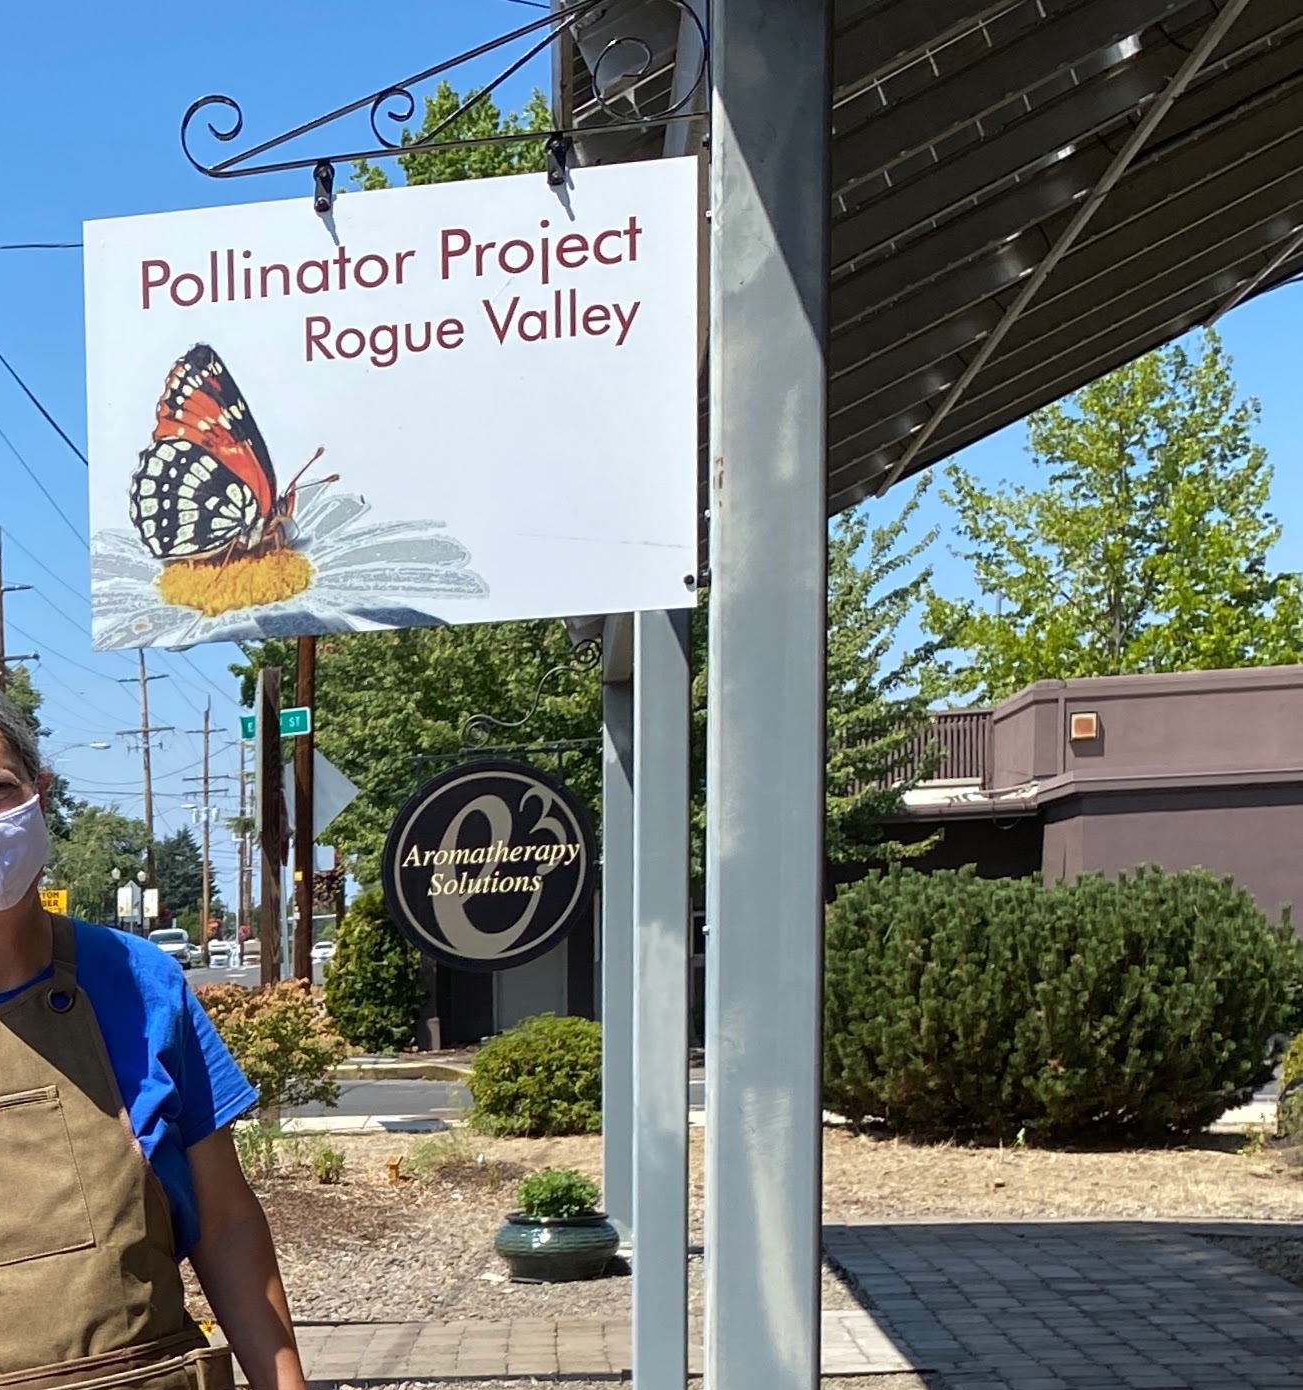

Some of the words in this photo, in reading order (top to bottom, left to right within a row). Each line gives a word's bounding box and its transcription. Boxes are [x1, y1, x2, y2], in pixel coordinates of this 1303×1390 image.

[140, 245, 416, 311] Pollinator
[439, 215, 643, 285] Project
[304, 316, 466, 368] Rogue
[481, 288, 642, 347] Valley
[289, 716, 300, 727] ST
[401, 839, 581, 868] Aromatherapy
[427, 872, 543, 897] Solutions
